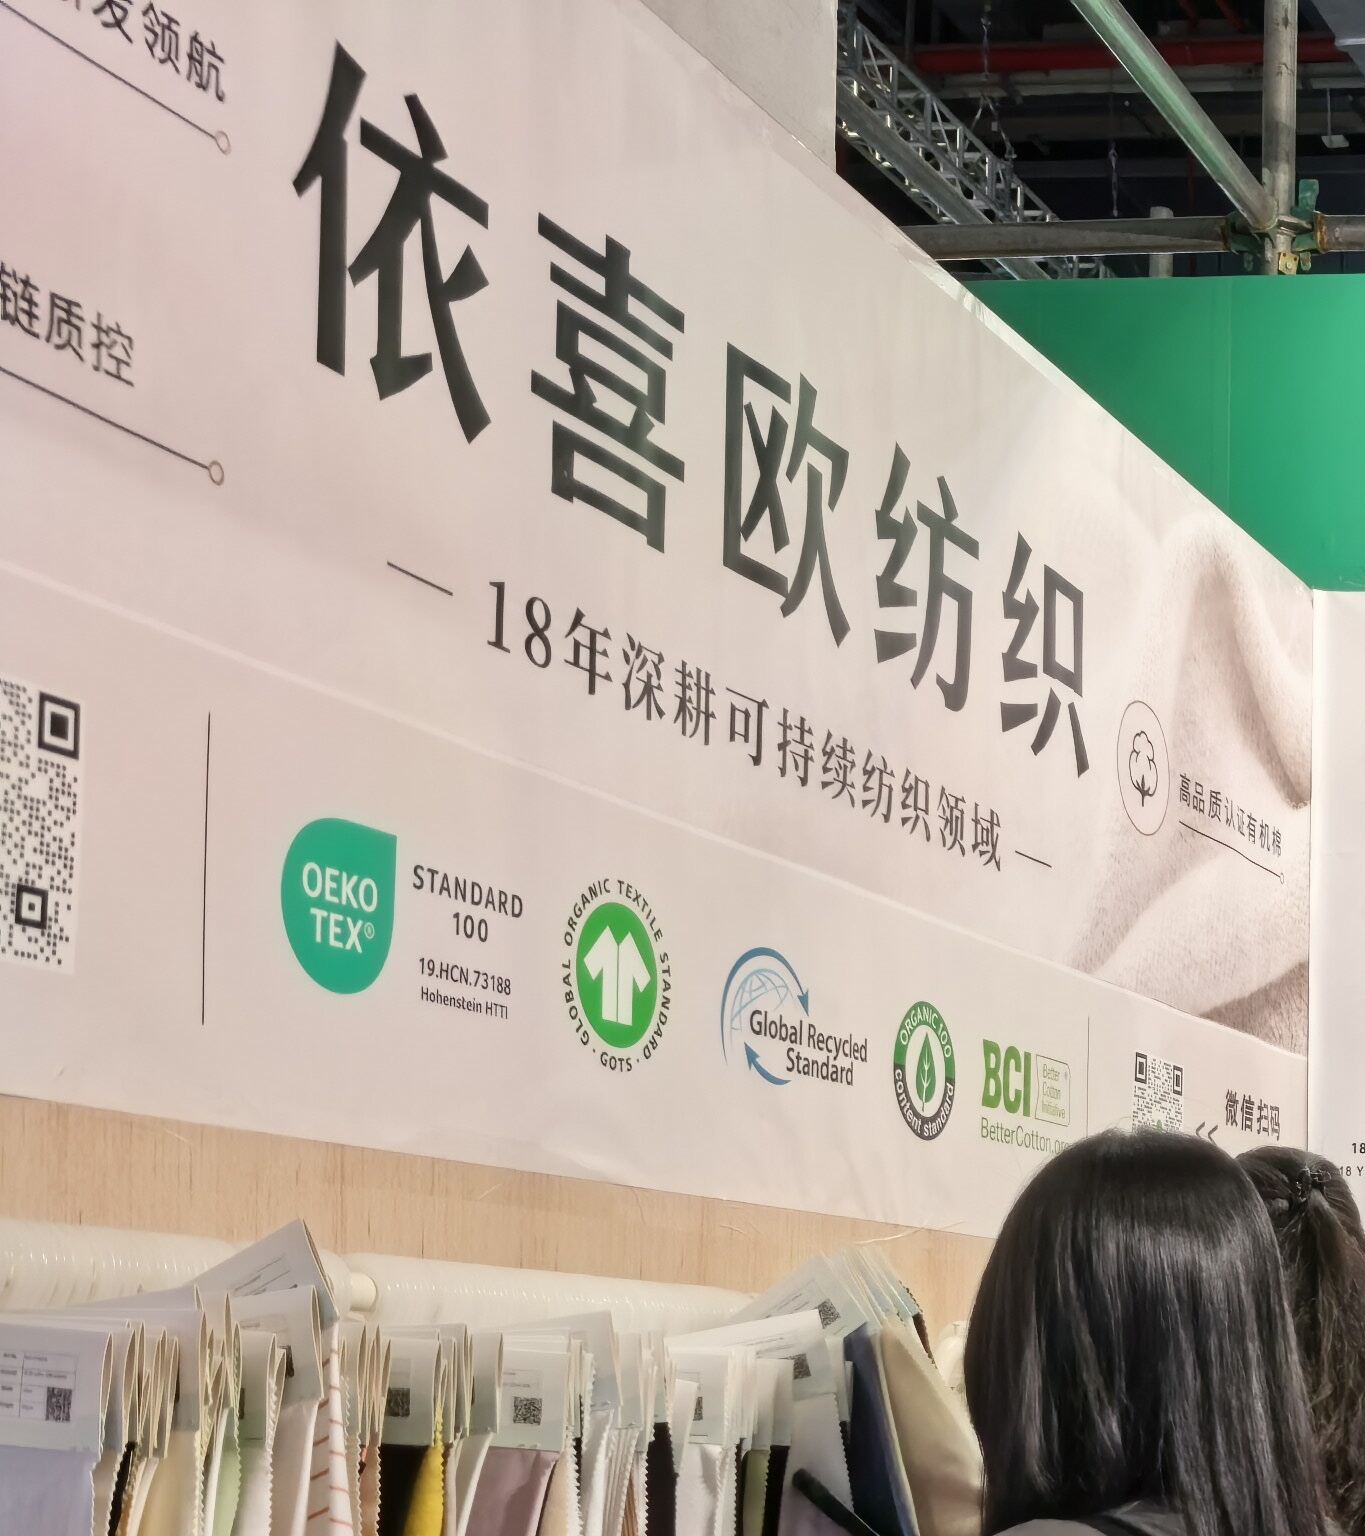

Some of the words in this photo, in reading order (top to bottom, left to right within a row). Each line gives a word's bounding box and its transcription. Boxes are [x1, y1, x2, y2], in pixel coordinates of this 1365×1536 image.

[62, 0, 226, 103] 发领航
[292, 40, 1090, 778] 依喜欧纺织
[486, 580, 1003, 873] 18年深耕可持续纺织领域
[1178, 772, 1283, 859] 高品质认证有机棉
[301, 861, 379, 912] OEKO
[412, 864, 525, 920] STANDARD
[563, 878, 611, 947] ORGANIC
[616, 879, 664, 943] TEXTILE
[451, 911, 490, 945] 100
[418, 956, 513, 998] 19.HCN.73188
[419, 986, 484, 1016] Hohenstein
[561, 957, 591, 1047] GLOBAL
[642, 951, 672, 1060] STANDARD
[599, 1050, 633, 1073] GOTS
[749, 1008, 804, 1047] Global
[806, 1023, 868, 1064] Recycled
[900, 1005, 939, 1046] ORGANIC
[937, 1022, 953, 1059] 100
[786, 1047, 854, 1087] Standard
[981, 1038, 1032, 1118] BCI
[894, 1068, 923, 1135] content
[922, 1081, 954, 1137] standard
[1225, 1088, 1281, 1141] 微信扫码
